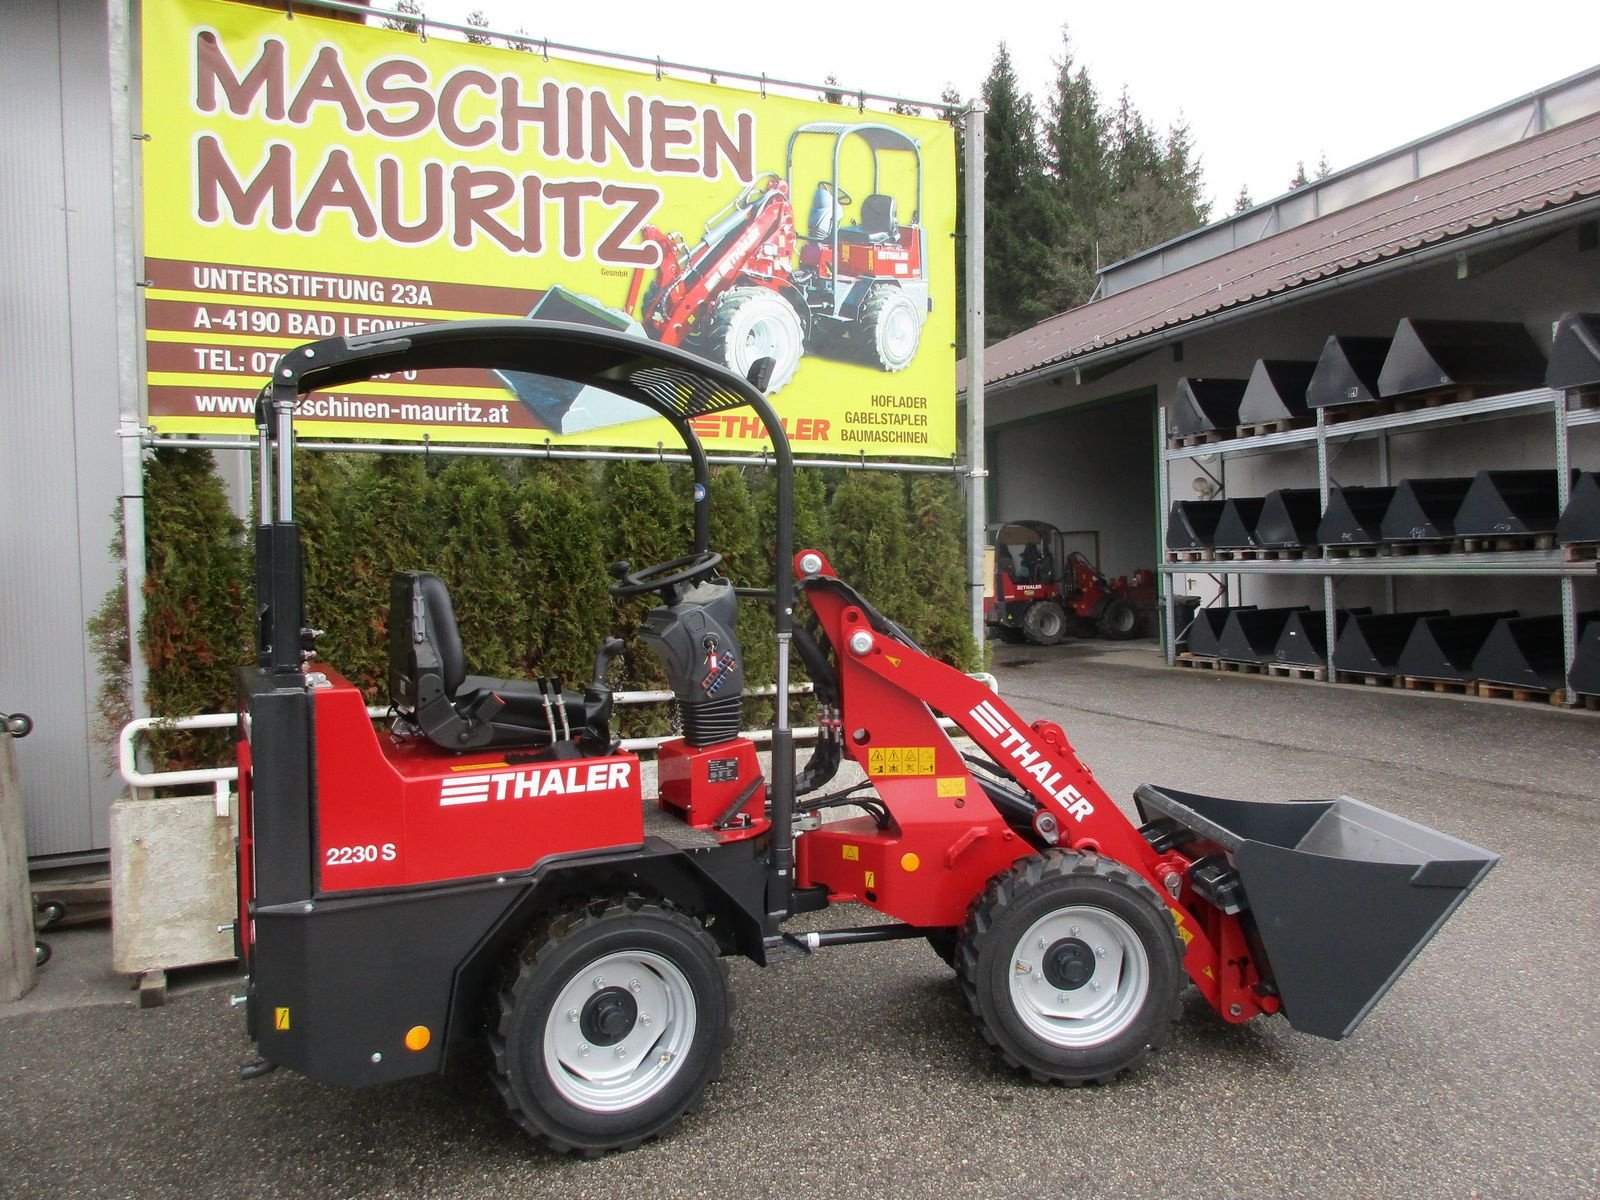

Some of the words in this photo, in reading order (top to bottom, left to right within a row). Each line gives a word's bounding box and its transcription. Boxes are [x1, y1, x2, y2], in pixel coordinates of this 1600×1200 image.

[196, 29, 753, 183] MASCHINEN
[196, 135, 663, 264] MAURITZ
[600, 267, 628, 278] GesmbH
[193, 267, 384, 303] UNTERSTIFTUNG
[391, 284, 433, 306] 23A
[193, 307, 281, 334] A-4190
[287, 312, 336, 337] BAD
[194, 348, 245, 372] TEL:
[871, 394, 928, 409] HOFLADER
[844, 410, 928, 427] GABELSTAPLER
[840, 428, 928, 444] BAUMASCHINEN
[490, 762, 631, 801] THALER
[1001, 727, 1095, 823] THALER
[326, 844, 377, 866] 2230
[381, 843, 396, 862] S
